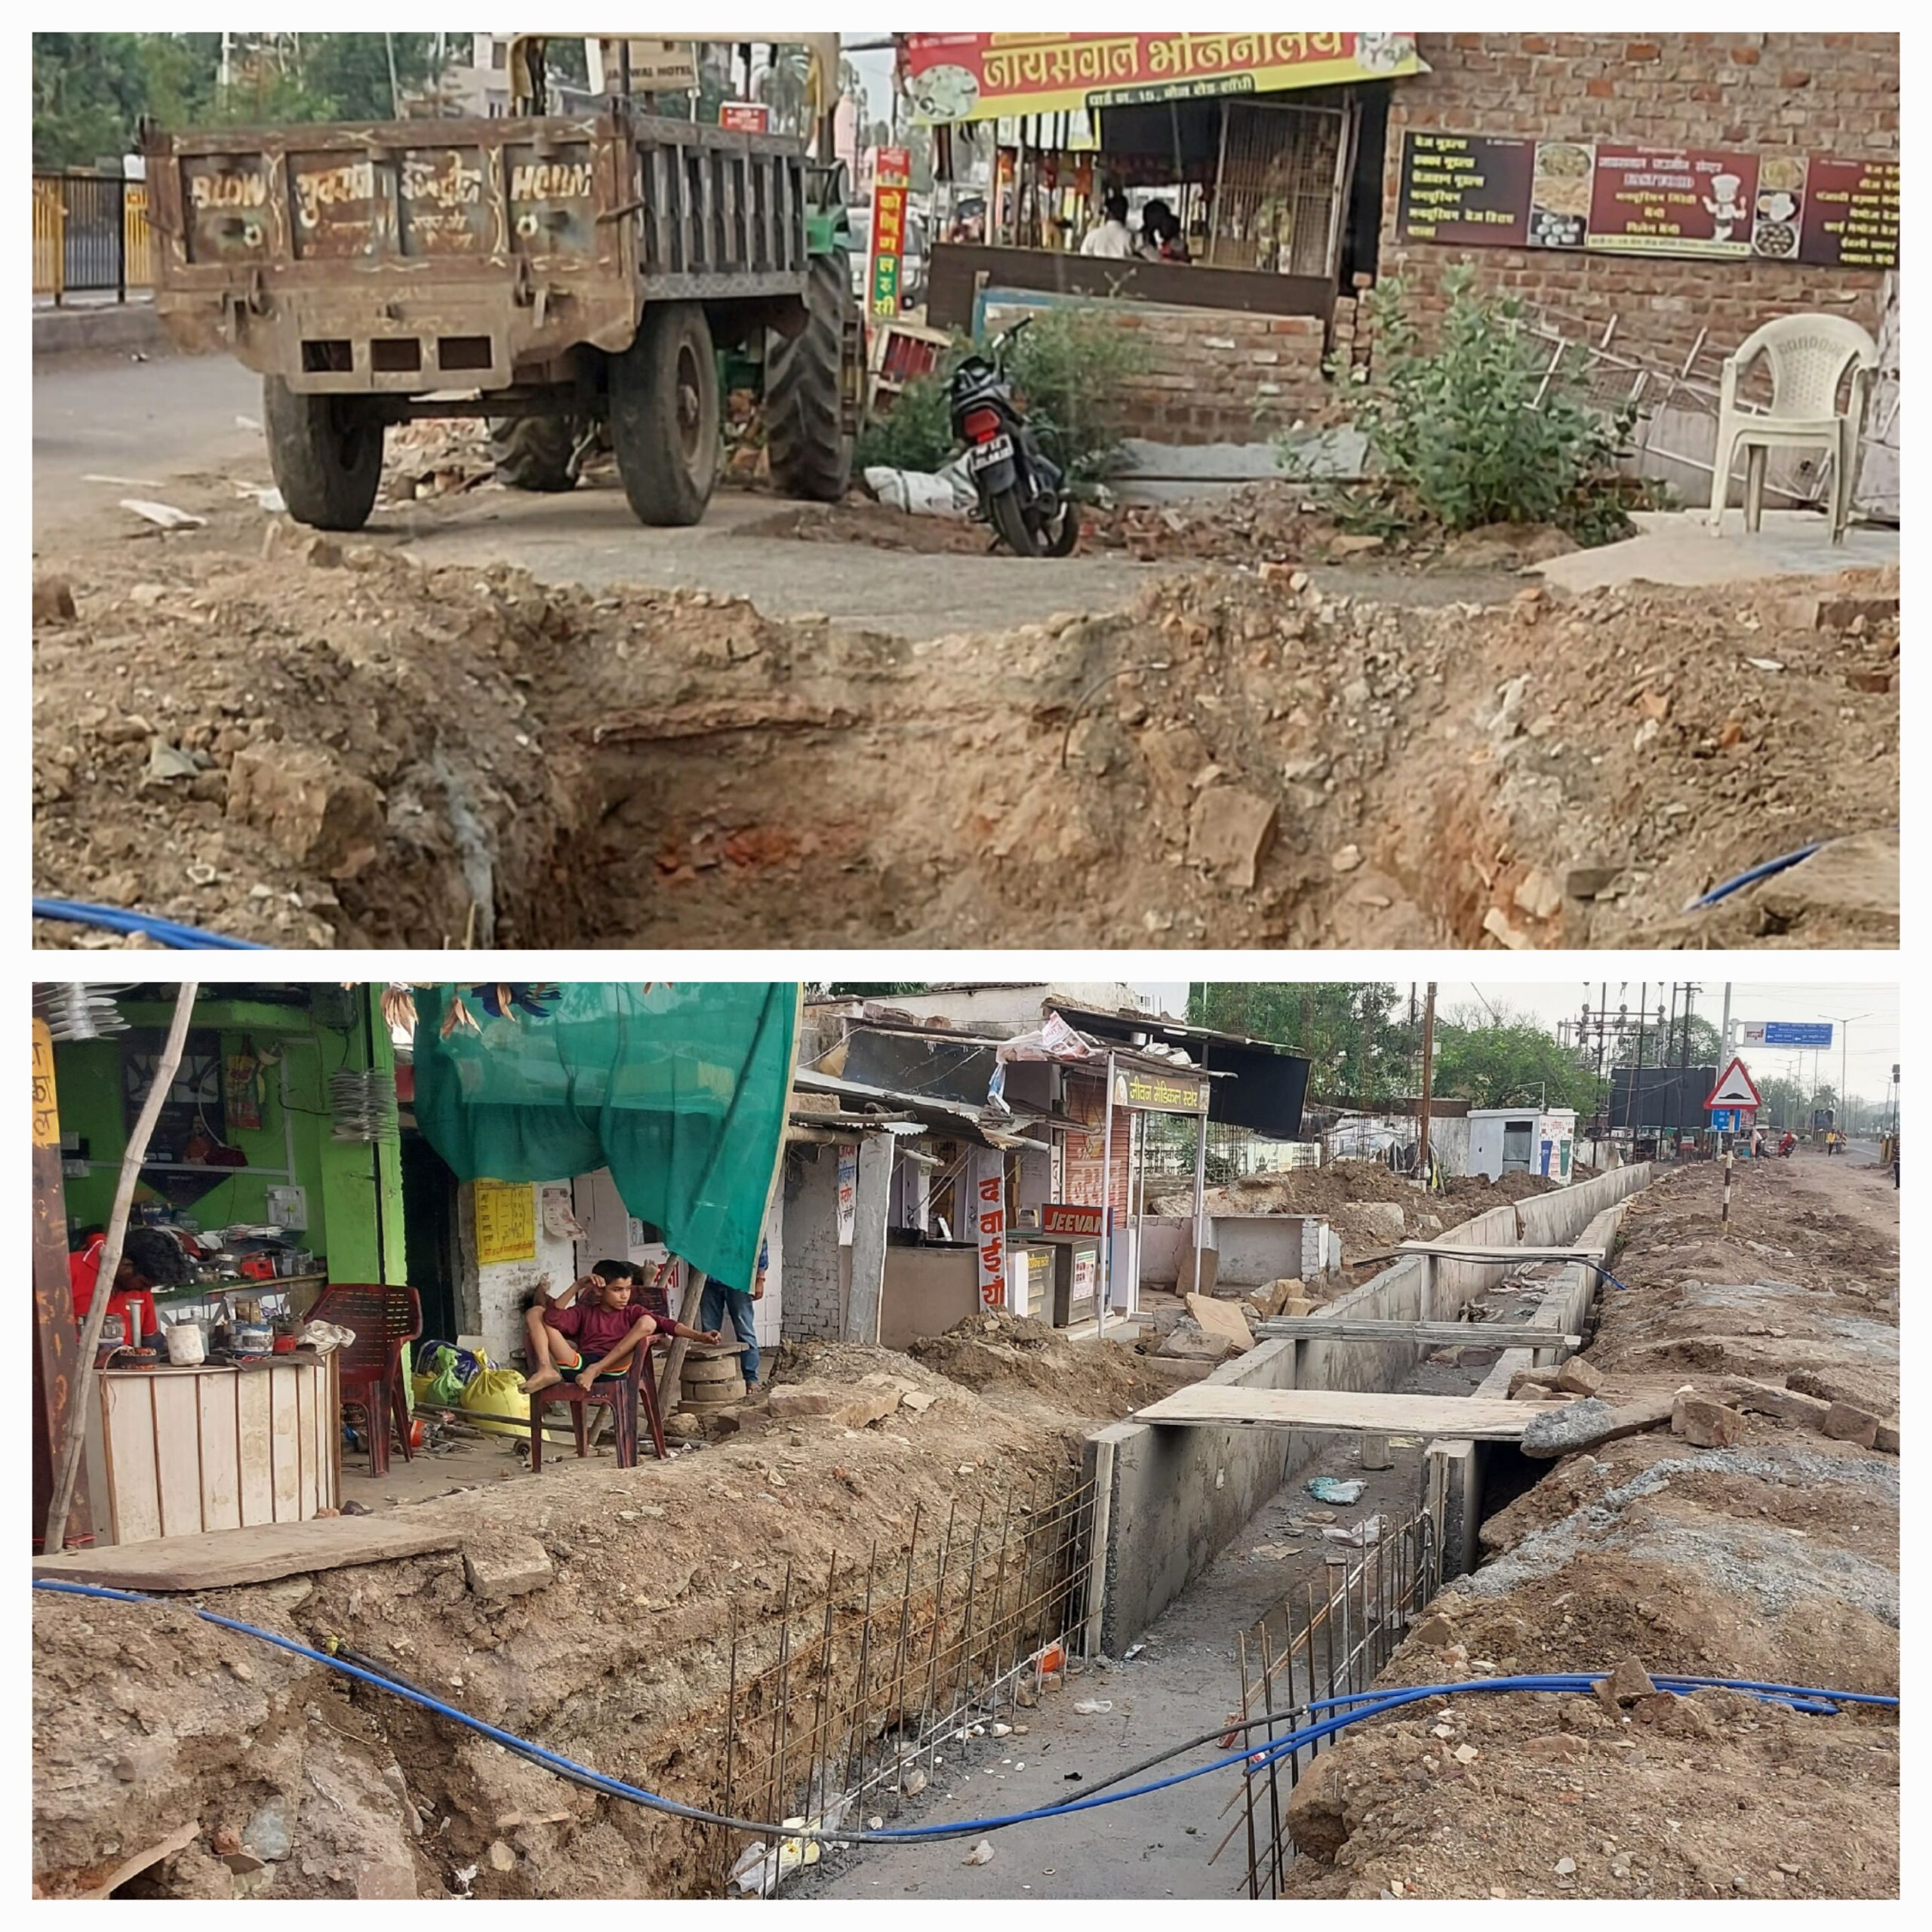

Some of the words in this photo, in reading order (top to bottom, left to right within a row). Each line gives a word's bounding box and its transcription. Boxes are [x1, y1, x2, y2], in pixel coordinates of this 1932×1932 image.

[607, 67, 653, 80] JAWAL
[657, 66, 692, 75] HOTEL
[982, 37, 1139, 89] जायसवाल
[192, 173, 266, 208] BLOW
[1044, 1211, 1103, 1234] JEEVAN
